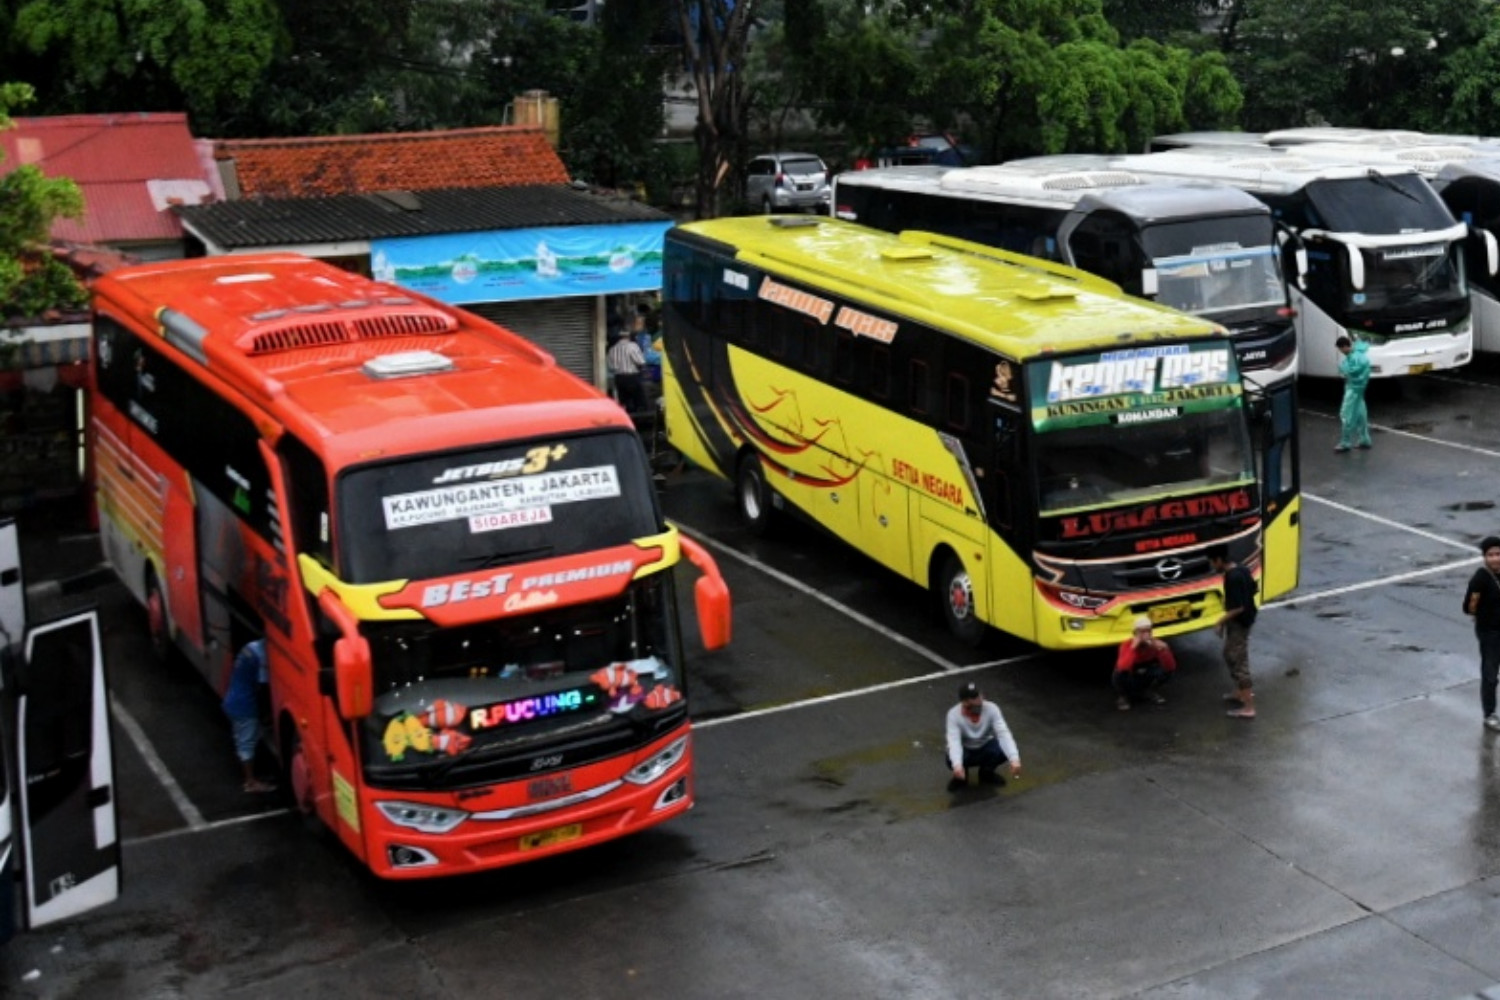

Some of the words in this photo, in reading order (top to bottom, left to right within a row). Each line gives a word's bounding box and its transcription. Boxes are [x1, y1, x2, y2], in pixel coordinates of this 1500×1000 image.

[1047, 397, 1125, 418] KUNINGAN
[1167, 386, 1235, 402] JAKARTA
[1117, 406, 1178, 424] KOMANDAN
[391, 482, 525, 514] KAWUNGANTEN
[541, 470, 613, 495] JAKARTA
[893, 458, 920, 485] SETIA
[922, 471, 964, 506] NEGARA
[474, 509, 548, 530] SIDAREJA
[521, 559, 634, 590] PREMIUM
